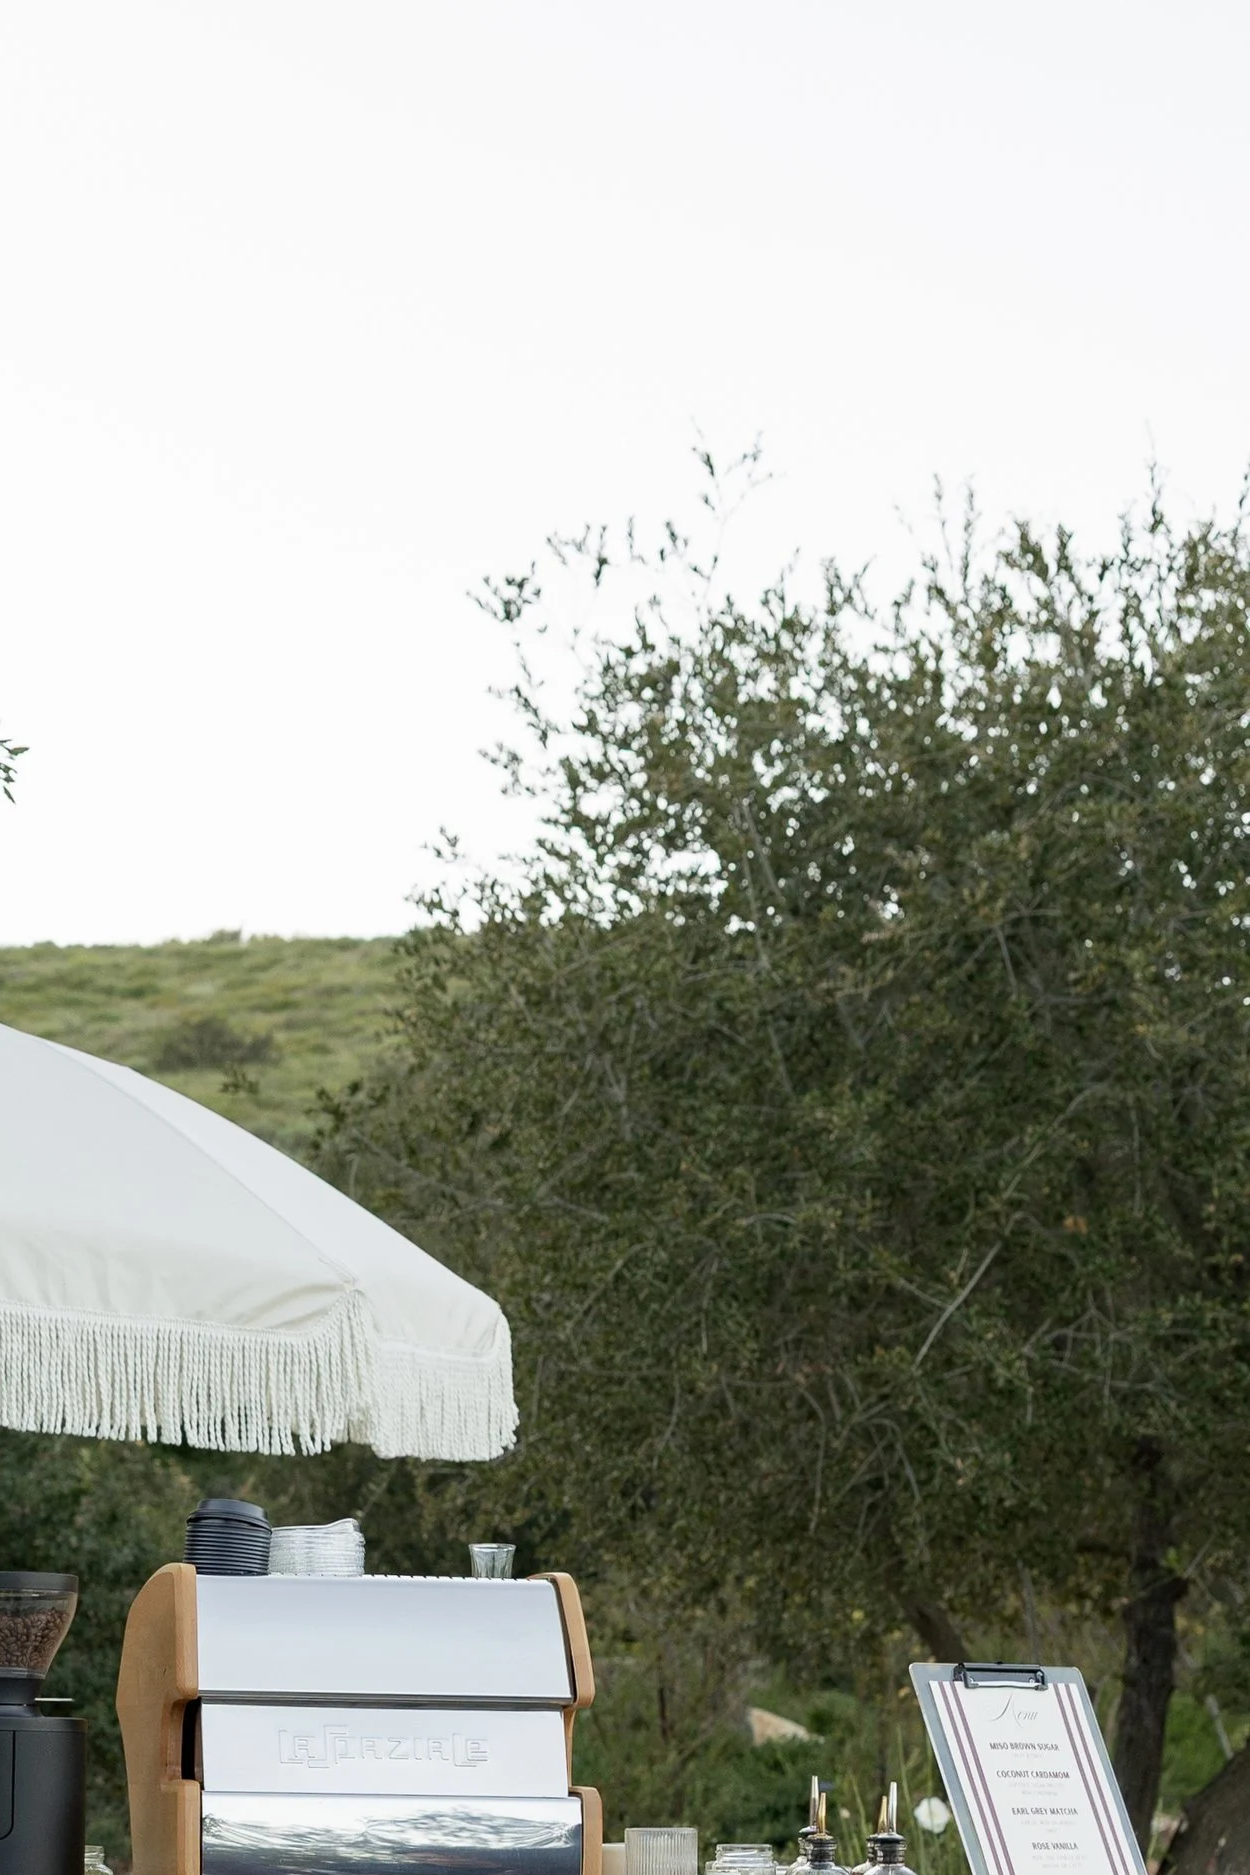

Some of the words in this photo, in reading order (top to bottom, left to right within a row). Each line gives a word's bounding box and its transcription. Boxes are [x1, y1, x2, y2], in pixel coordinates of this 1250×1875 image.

[1037, 1743, 1059, 1751] SUGAR
[997, 1770, 1029, 1778] COCONUT
[1031, 1770, 1070, 1779] CARDAMOM
[1012, 1807, 1030, 1815] EARL
[1031, 1807, 1048, 1815] GREY
[1049, 1807, 1078, 1815] MATCHA
[1032, 1842, 1050, 1850] ROSE
[1052, 1842, 1079, 1850] VANILLA
